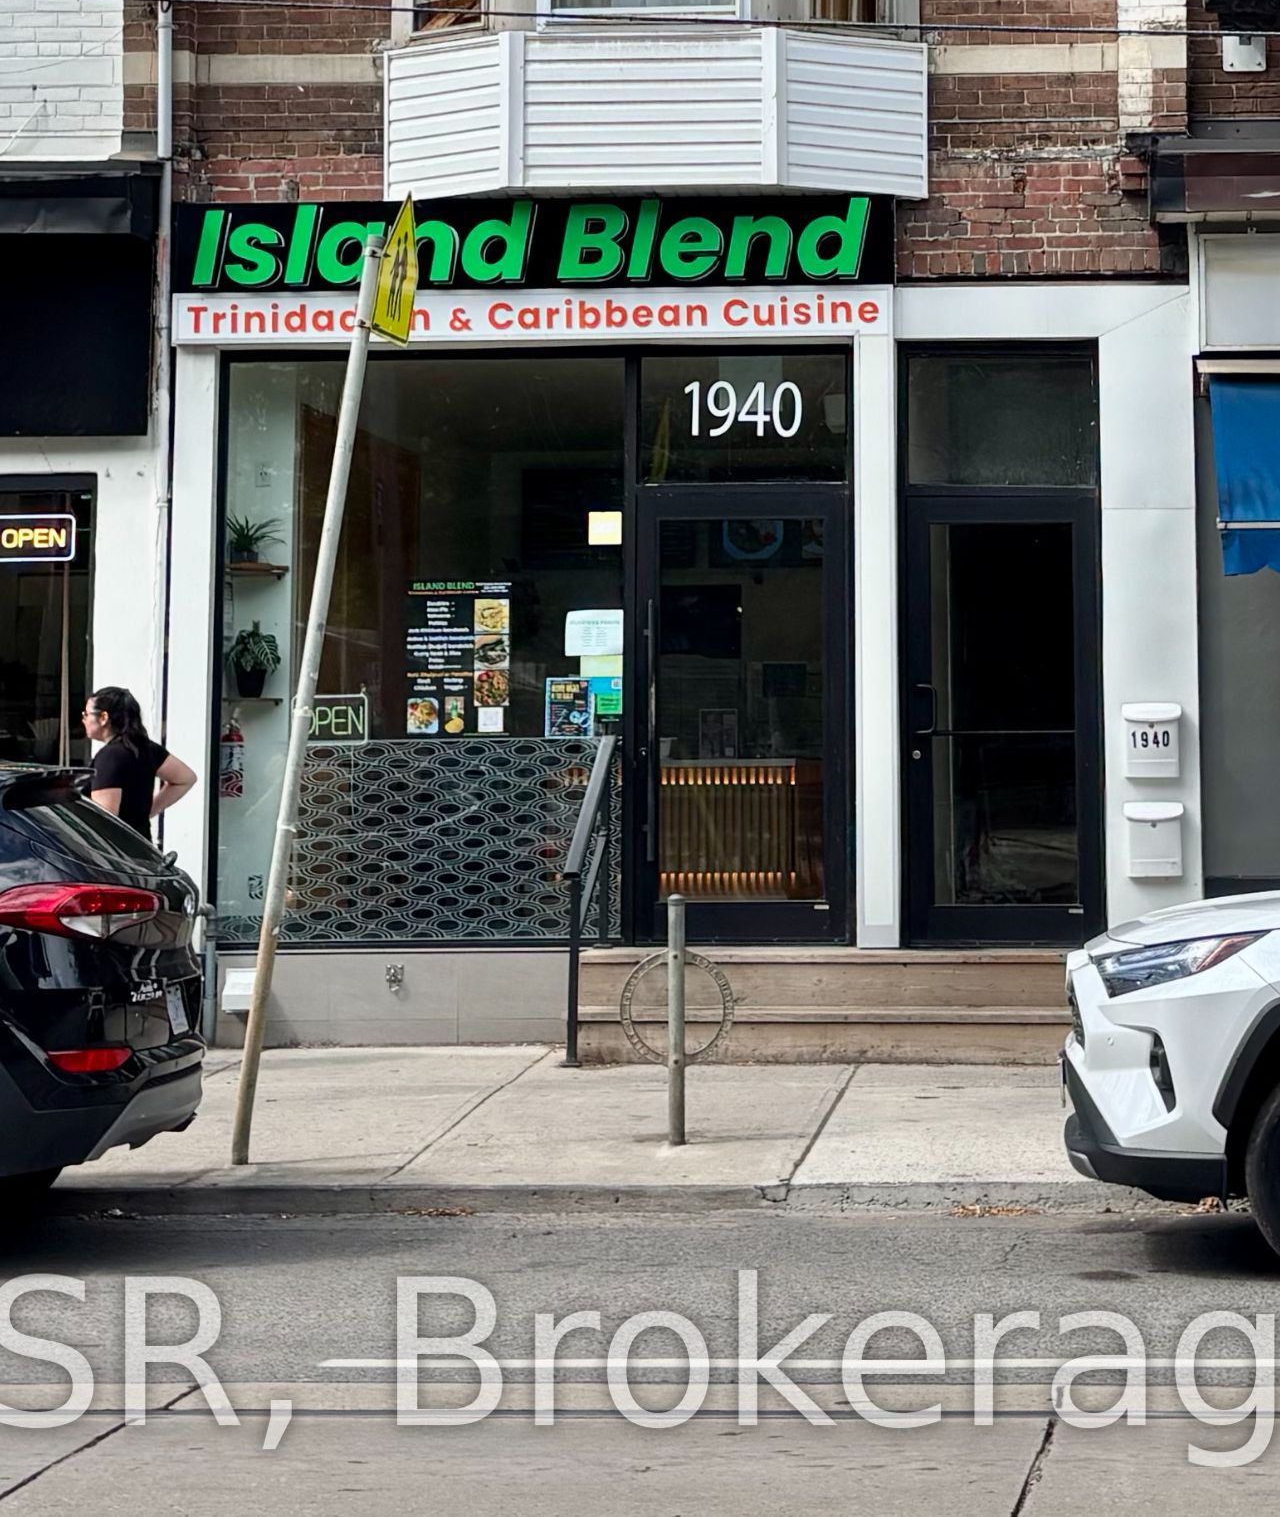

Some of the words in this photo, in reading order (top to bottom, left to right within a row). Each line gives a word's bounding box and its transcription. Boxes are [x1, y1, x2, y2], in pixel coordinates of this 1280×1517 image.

[192, 200, 539, 288] Island
[557, 196, 872, 282] Blend
[187, 303, 430, 333] Trinidan
[449, 307, 472, 331] &
[488, 299, 708, 331] Caribbean
[723, 294, 880, 327] Cuisine
[684, 381, 803, 438] 1940
[1, 528, 66, 549] OPEN
[1131, 730, 1170, 749] 1940
